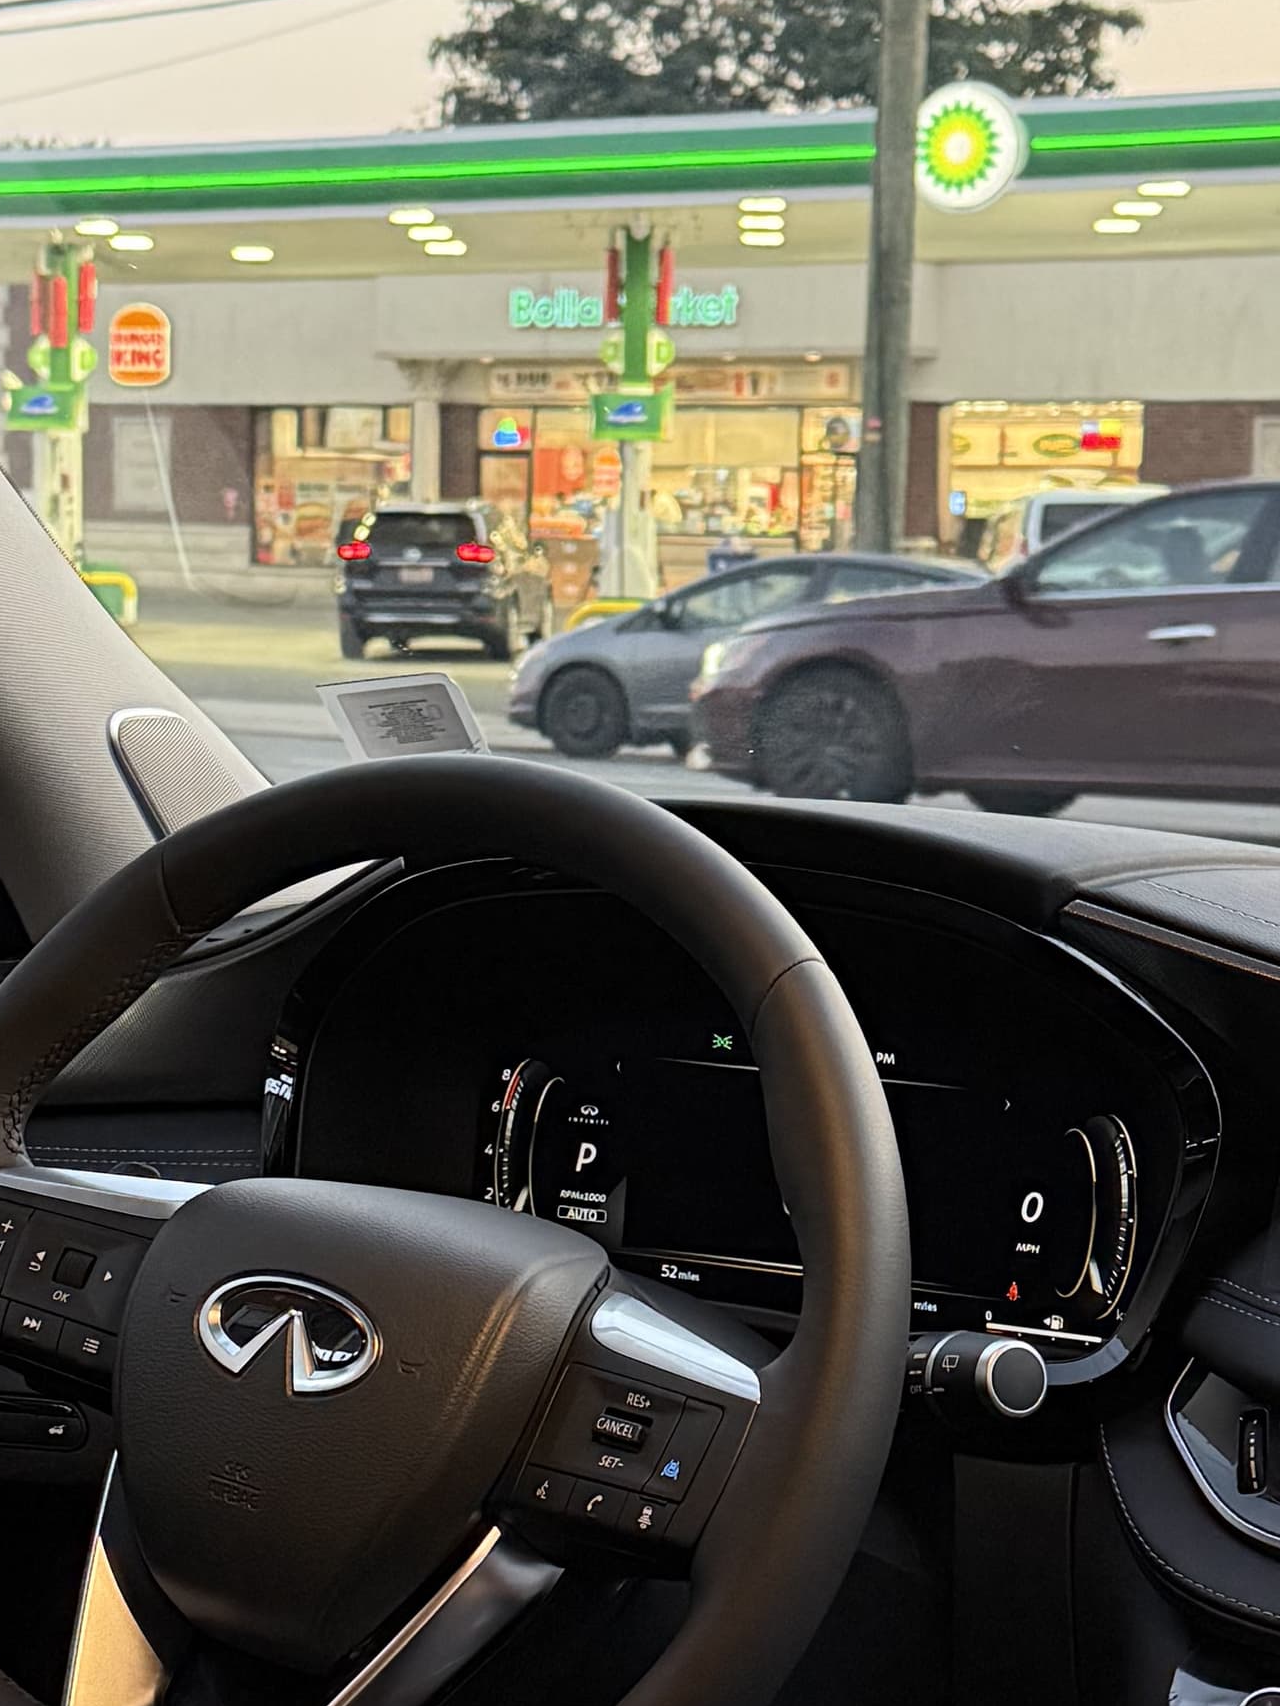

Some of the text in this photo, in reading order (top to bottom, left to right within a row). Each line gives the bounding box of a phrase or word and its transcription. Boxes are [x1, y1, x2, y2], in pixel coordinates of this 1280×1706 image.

[509, 286, 604, 328] Bolla
[876, 1052, 896, 1066] PM
[502, 1069, 511, 1081] 8
[491, 1100, 500, 1112] 6
[484, 1144, 493, 1155] 4
[575, 1142, 598, 1173] P
[484, 1188, 494, 1200] 2
[1021, 1191, 1045, 1223] 0
[567, 1208, 599, 1223] AUTO
[1015, 1242, 1041, 1255] MPH
[660, 1264, 700, 1283] 52 miles
[52, 1289, 71, 1303] OK
[985, 1310, 993, 1322] 0
[626, 1392, 651, 1408] RES+
[596, 1417, 634, 1439] CANCEL
